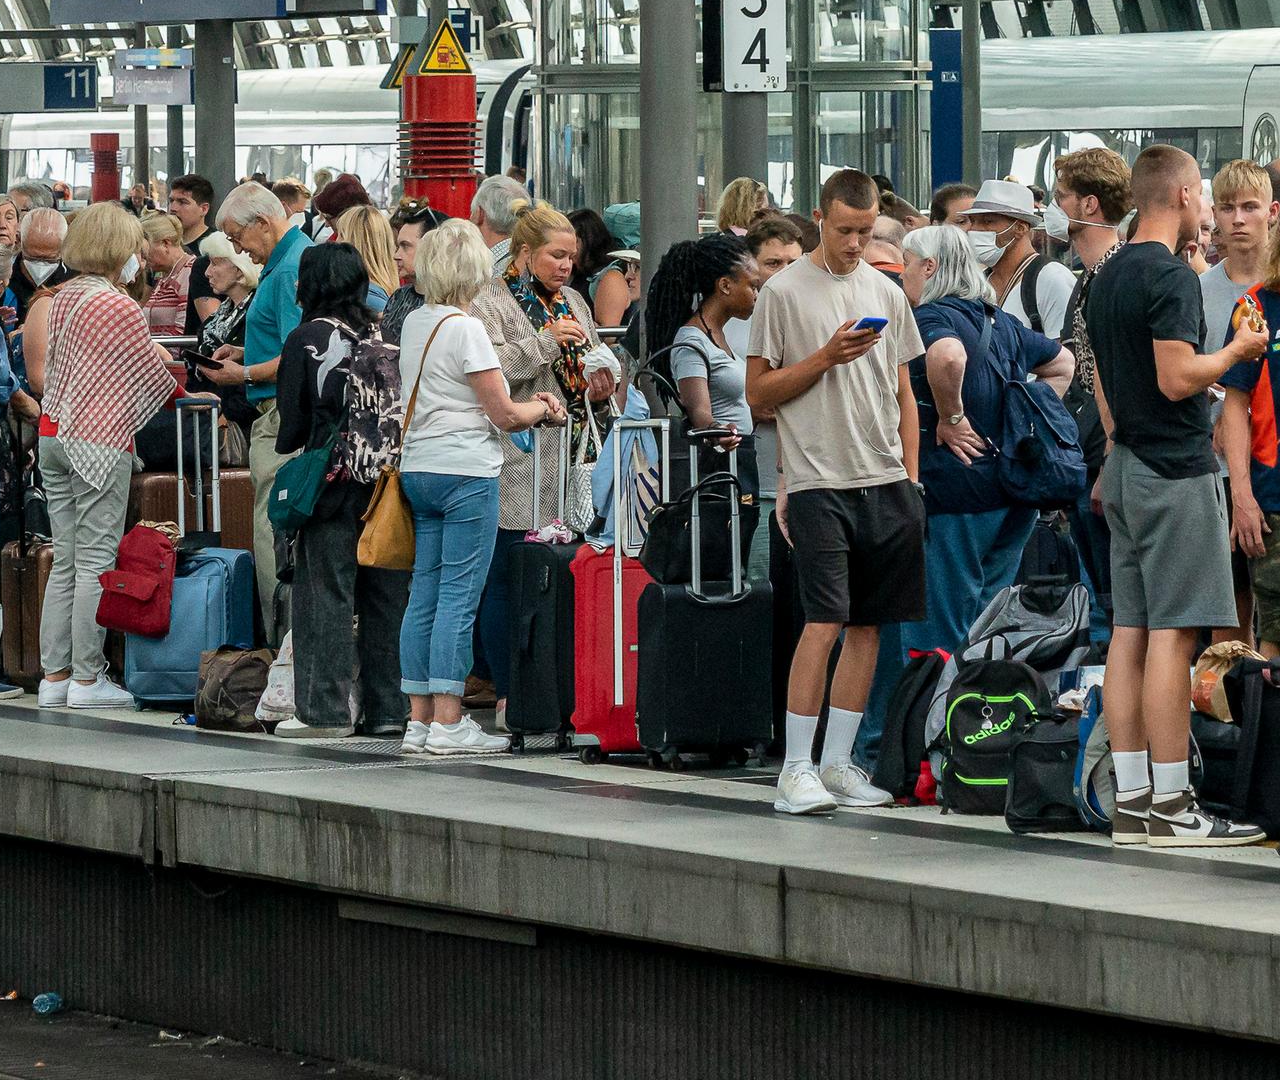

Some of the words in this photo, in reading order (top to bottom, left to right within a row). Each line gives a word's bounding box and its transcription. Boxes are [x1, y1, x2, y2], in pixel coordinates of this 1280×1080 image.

[741, 28, 770, 73] 4
[64, 68, 90, 99] 11
[964, 711, 1016, 745] adidas
